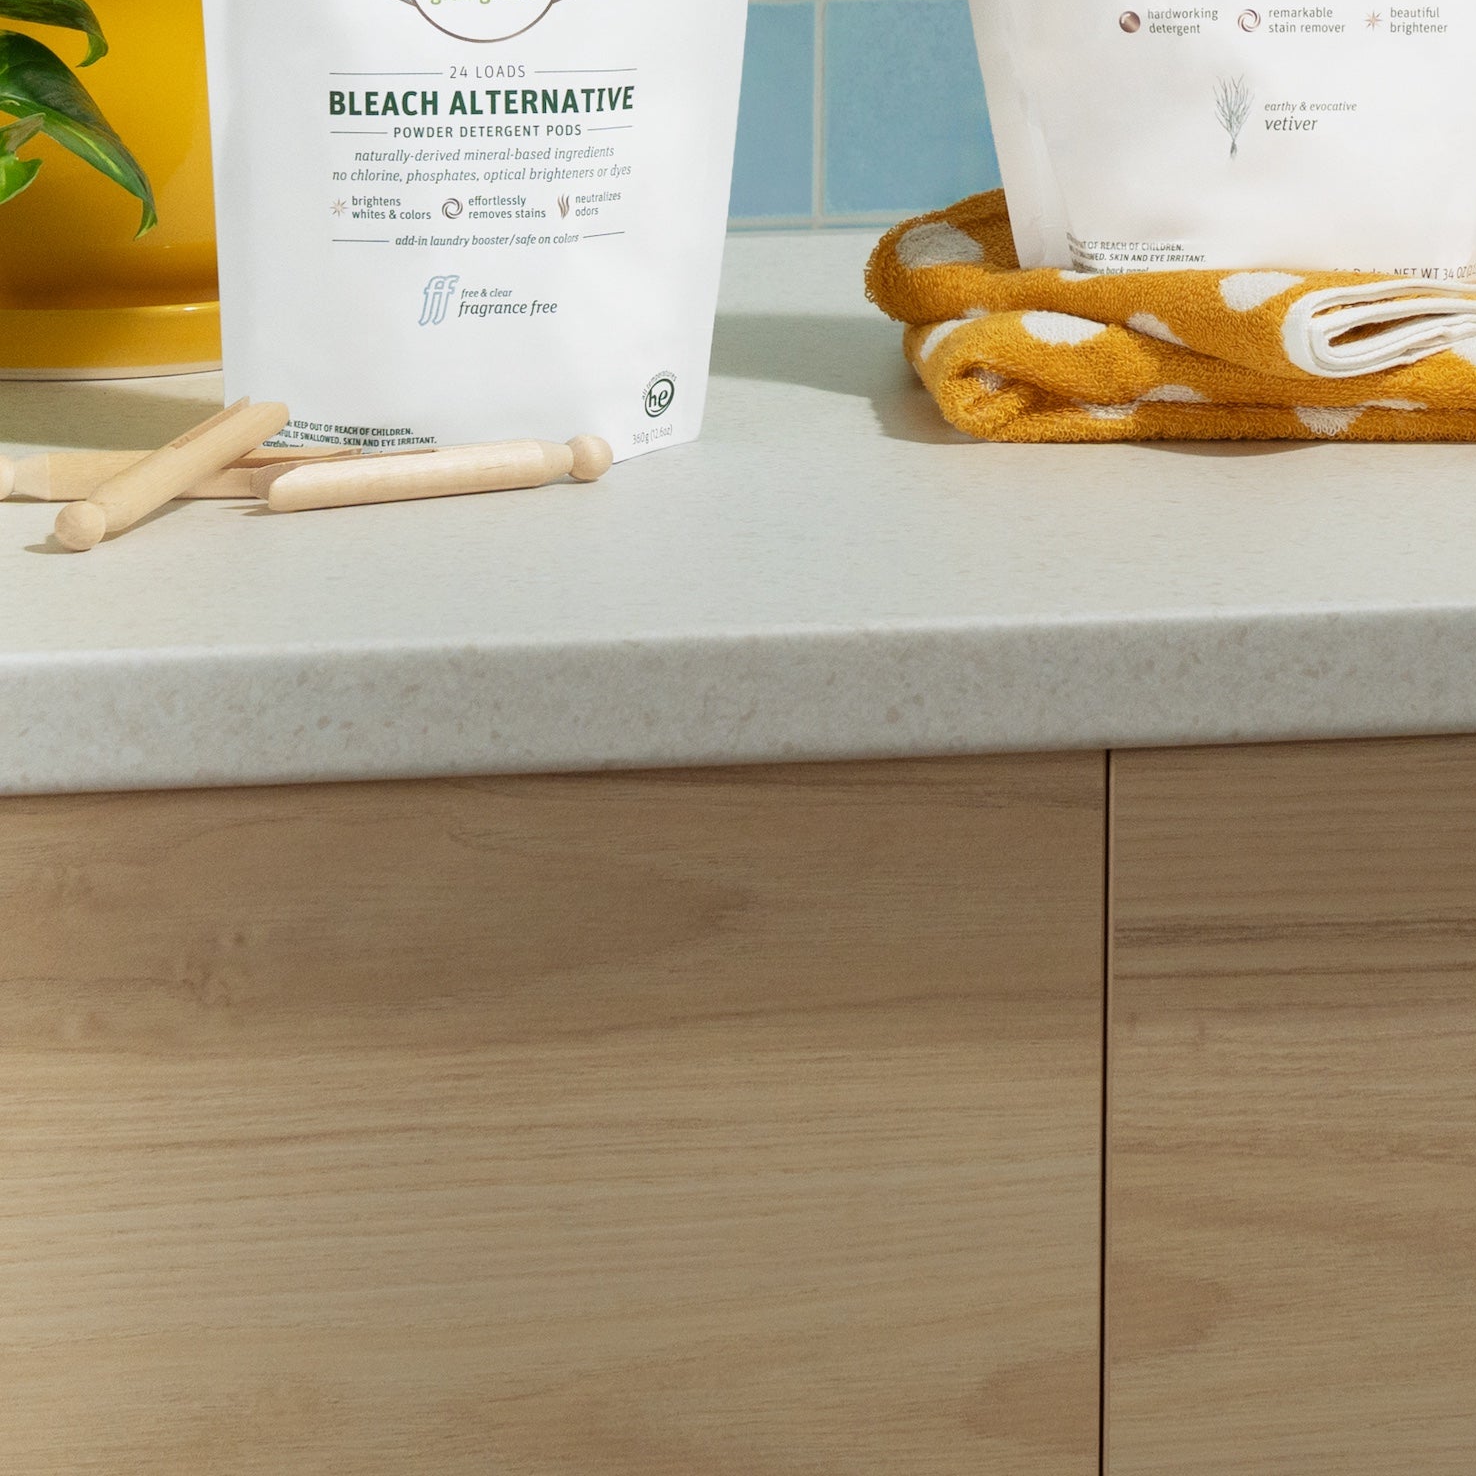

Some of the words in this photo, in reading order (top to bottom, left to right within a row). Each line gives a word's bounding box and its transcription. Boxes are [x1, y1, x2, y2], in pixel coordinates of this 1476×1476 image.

[1148, 8, 1218, 21] hardworking
[1269, 7, 1333, 18] remarkable
[1390, 7, 1439, 18] beautiful
[1149, 23, 1200, 36] detergent
[1269, 22, 1296, 33] stain
[1301, 24, 1345, 33] remover
[1390, 22, 1447, 35] brightener
[450, 66, 467, 79] 24
[476, 65, 525, 78] LOADS
[330, 91, 438, 116] BLEACH
[449, 86, 634, 115] ALTERNATIVE
[1264, 101, 1297, 113] earthy
[1299, 101, 1307, 111] &
[1310, 102, 1357, 111] evocative
[1265, 116, 1317, 131] vetiver
[394, 127, 452, 138] POWDER
[460, 125, 539, 137] DETERGENT
[547, 124, 581, 136] PODS
[355, 149, 460, 164] naturally-derived
[464, 148, 551, 160] mineral-based
[555, 146, 614, 162] ingredients
[333, 172, 347, 180] no
[351, 169, 402, 182] chlorine,
[406, 169, 479, 184] phosphates,
[484, 168, 526, 183] optical
[529, 167, 594, 182] brighteners
[597, 168, 608, 177] or
[610, 164, 631, 178] dyes
[352, 196, 401, 208] brightens
[468, 195, 526, 207] effortlessly
[576, 192, 621, 203] neutralizes
[352, 209, 385, 219] whites
[389, 209, 396, 219] &
[400, 210, 431, 219] colors
[469, 211, 512, 219] removes
[515, 208, 546, 218] stains
[575, 206, 598, 217] odors
[395, 235, 427, 246] add-in
[430, 236, 470, 247] laundry
[472, 234, 536, 246] booster/safe
[538, 236, 550, 244] on
[553, 233, 579, 244] colors
[461, 289, 479, 299] free
[480, 289, 487, 297] &
[490, 288, 512, 297] clear
[458, 301, 527, 317] fragrance
[530, 300, 557, 316] free
[293, 420, 308, 429] KEEP
[310, 422, 322, 431] OUT
[324, 424, 333, 432] OF
[335, 425, 357, 434] REACH
[371, 428, 413, 436] CHILDREN.
[343, 437, 361, 446] SKIN
[362, 438, 380, 447] AND
[398, 436, 437, 446] IRRITANT.
